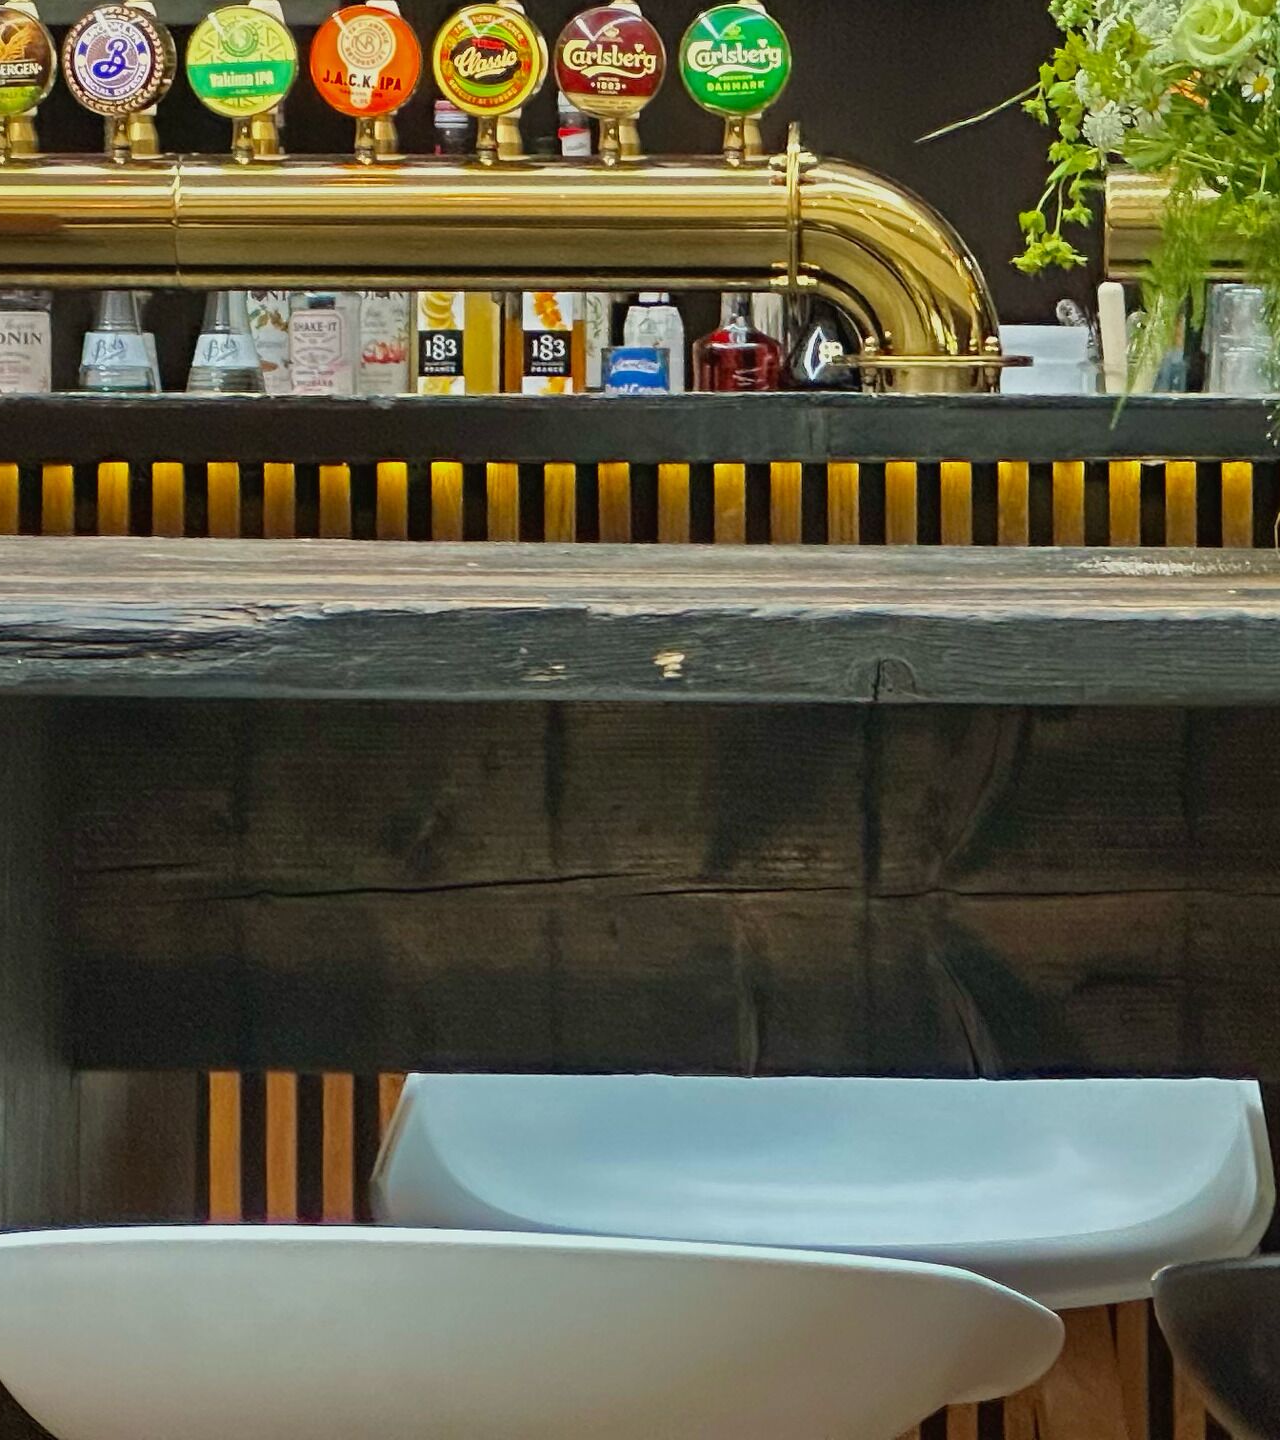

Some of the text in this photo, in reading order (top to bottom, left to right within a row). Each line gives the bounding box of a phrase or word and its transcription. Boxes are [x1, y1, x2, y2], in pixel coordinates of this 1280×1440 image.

[453, 46, 518, 78] Classic
[562, 39, 658, 79] Carlsberg
[686, 39, 783, 79] Carlsberg
[208, 70, 275, 88] Yakima IPA
[321, 68, 402, 91] J.A.C.K. IPA
[706, 80, 766, 92] DANMARK
[293, 320, 338, 333] SHAKE-IT
